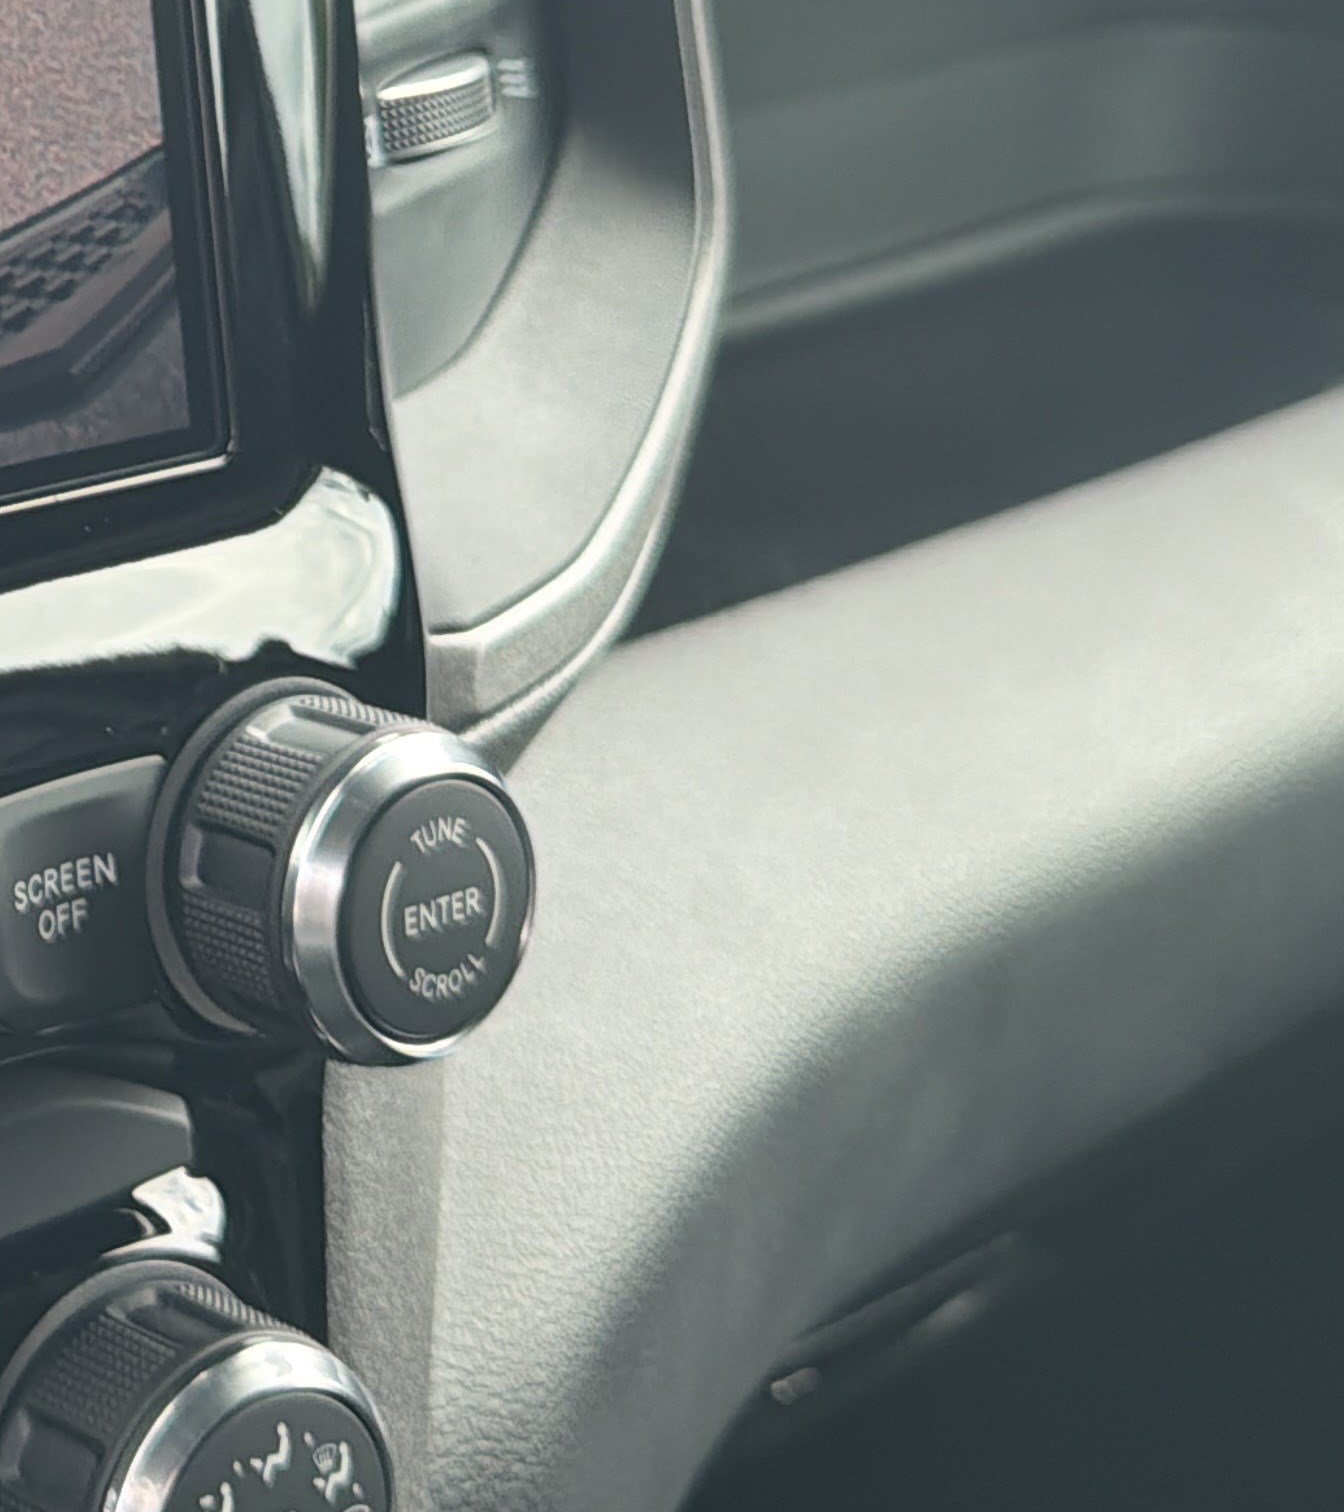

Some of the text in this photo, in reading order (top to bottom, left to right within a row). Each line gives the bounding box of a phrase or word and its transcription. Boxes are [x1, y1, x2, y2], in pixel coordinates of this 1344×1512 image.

[410, 816, 471, 854] TUNE
[14, 853, 116, 913] SCREEN
[38, 897, 88, 942] OFF
[404, 886, 483, 937] ENTER
[409, 953, 487, 998] SCROLL
